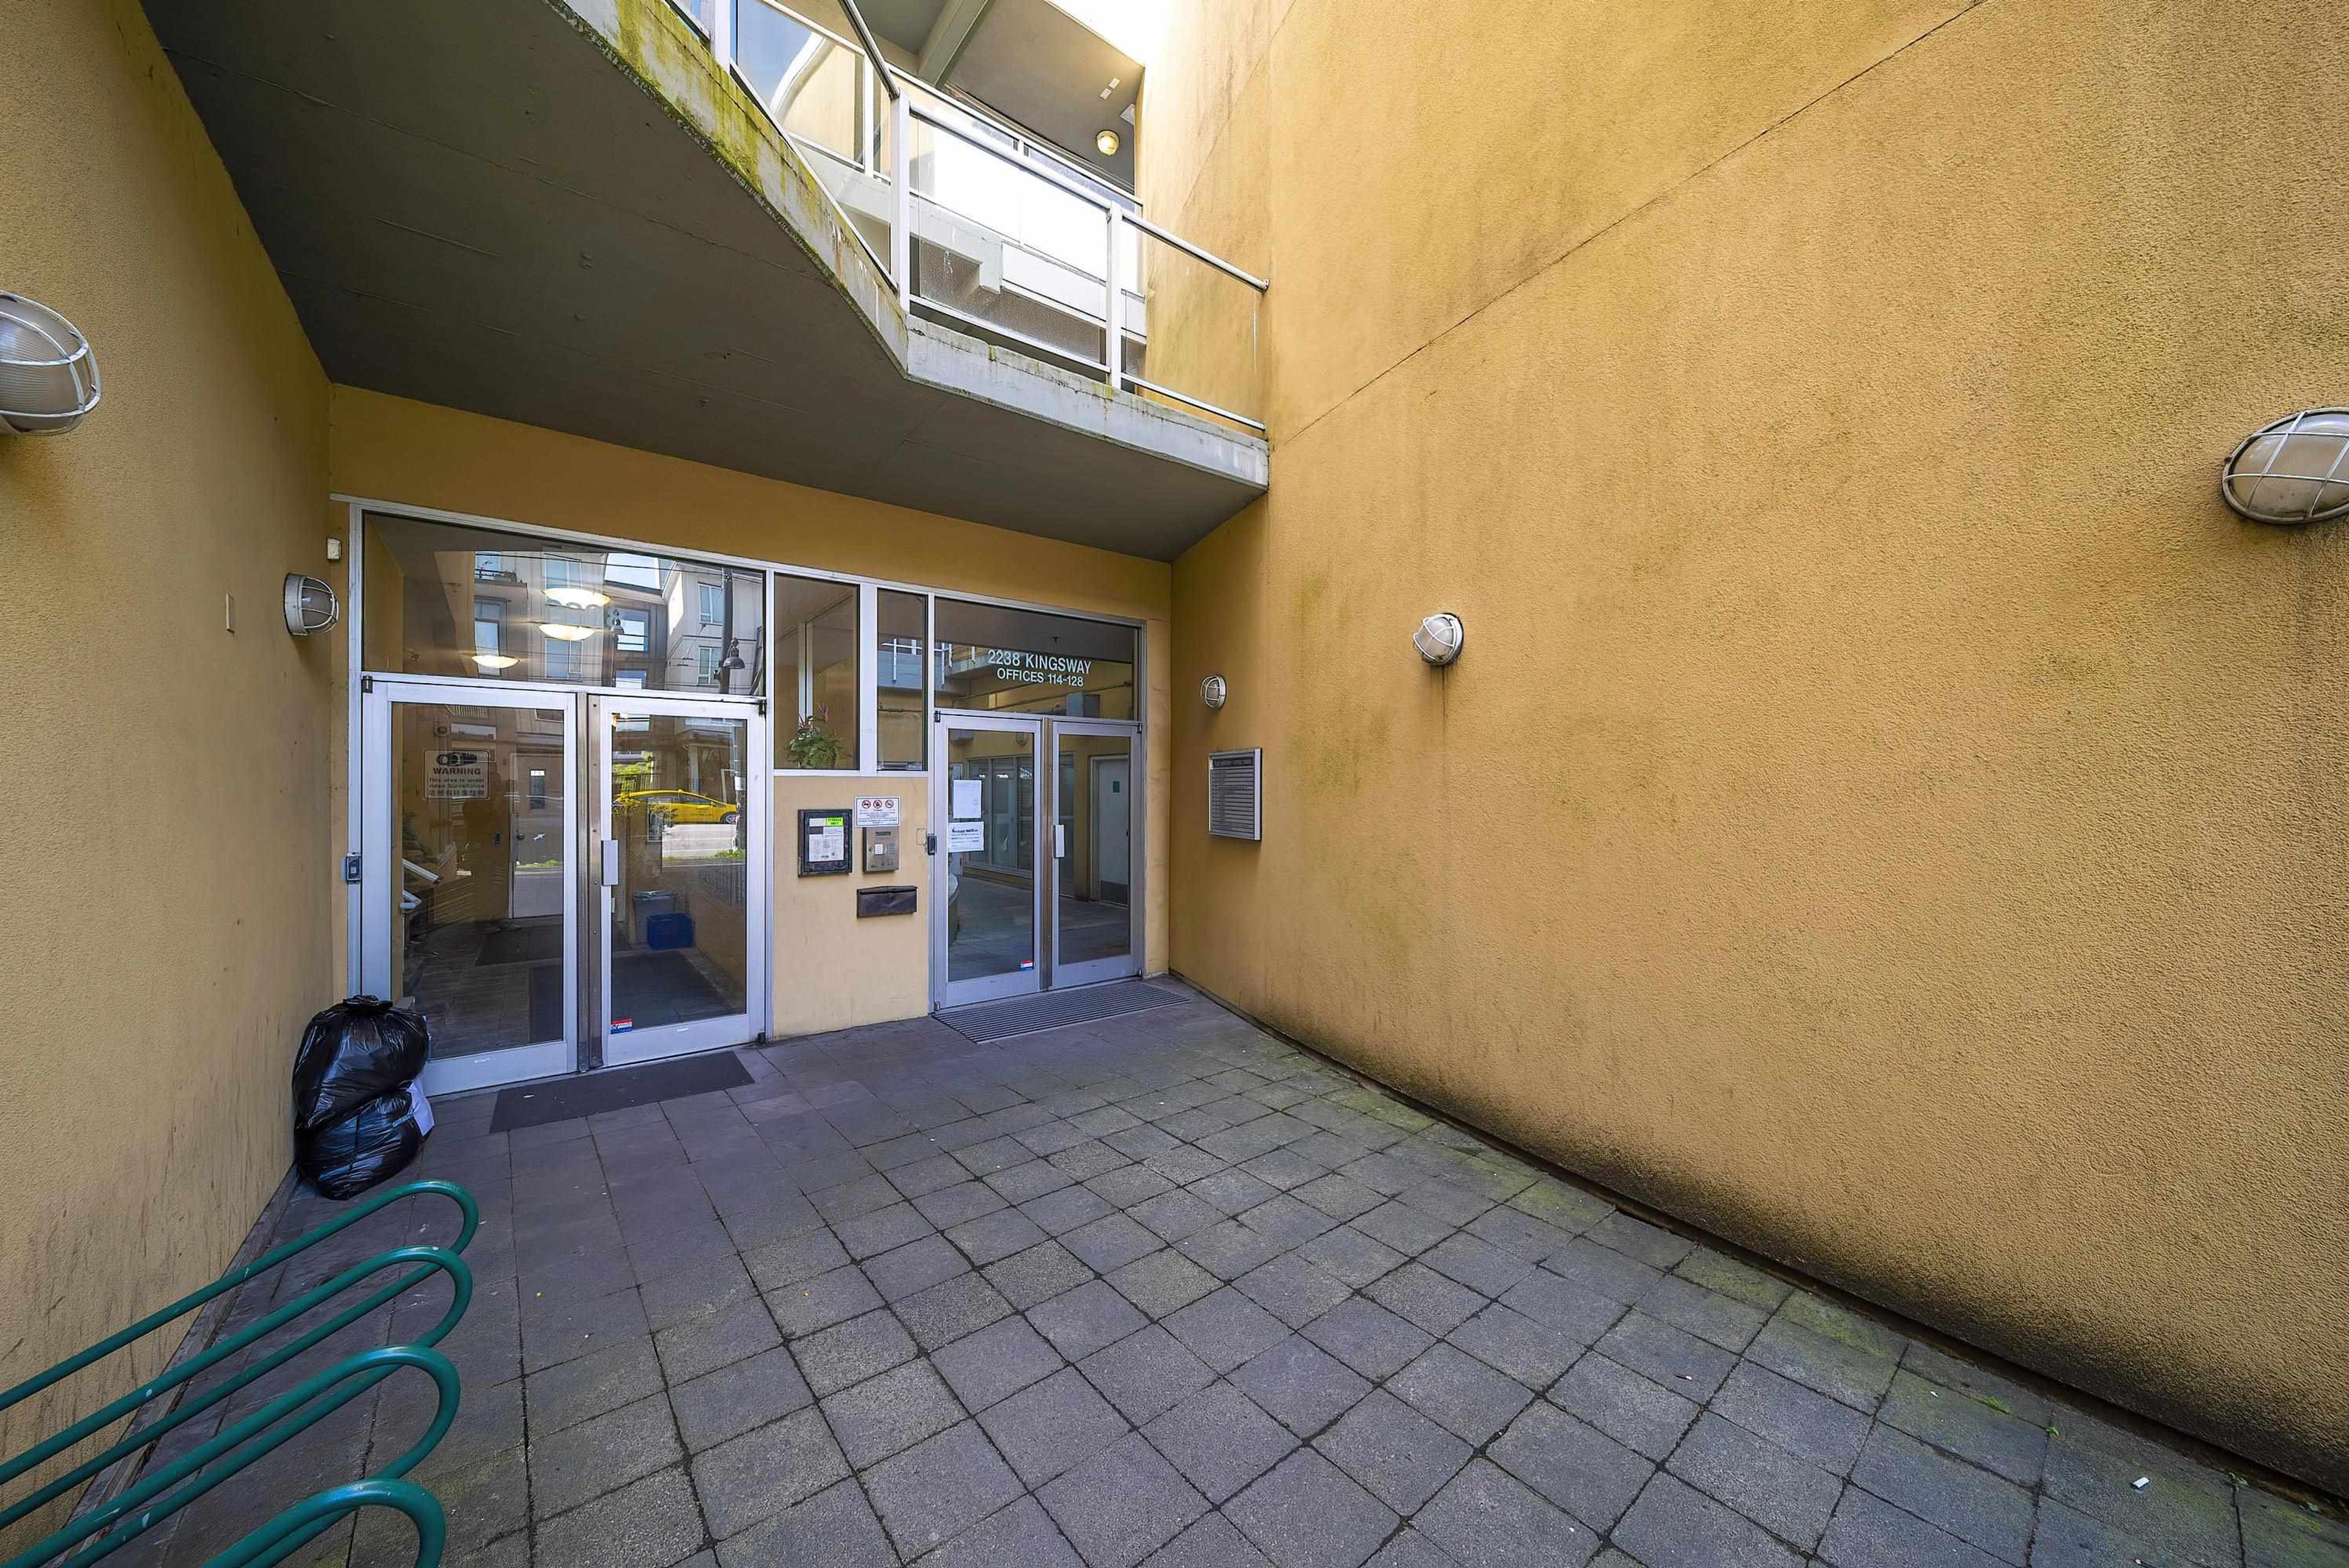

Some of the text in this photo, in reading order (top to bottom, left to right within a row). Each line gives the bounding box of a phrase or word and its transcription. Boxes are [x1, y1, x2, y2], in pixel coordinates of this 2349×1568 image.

[988, 649, 1091, 675] 2238 KINGSWAY
[997, 668, 1084, 687] OFFICES 114-128
